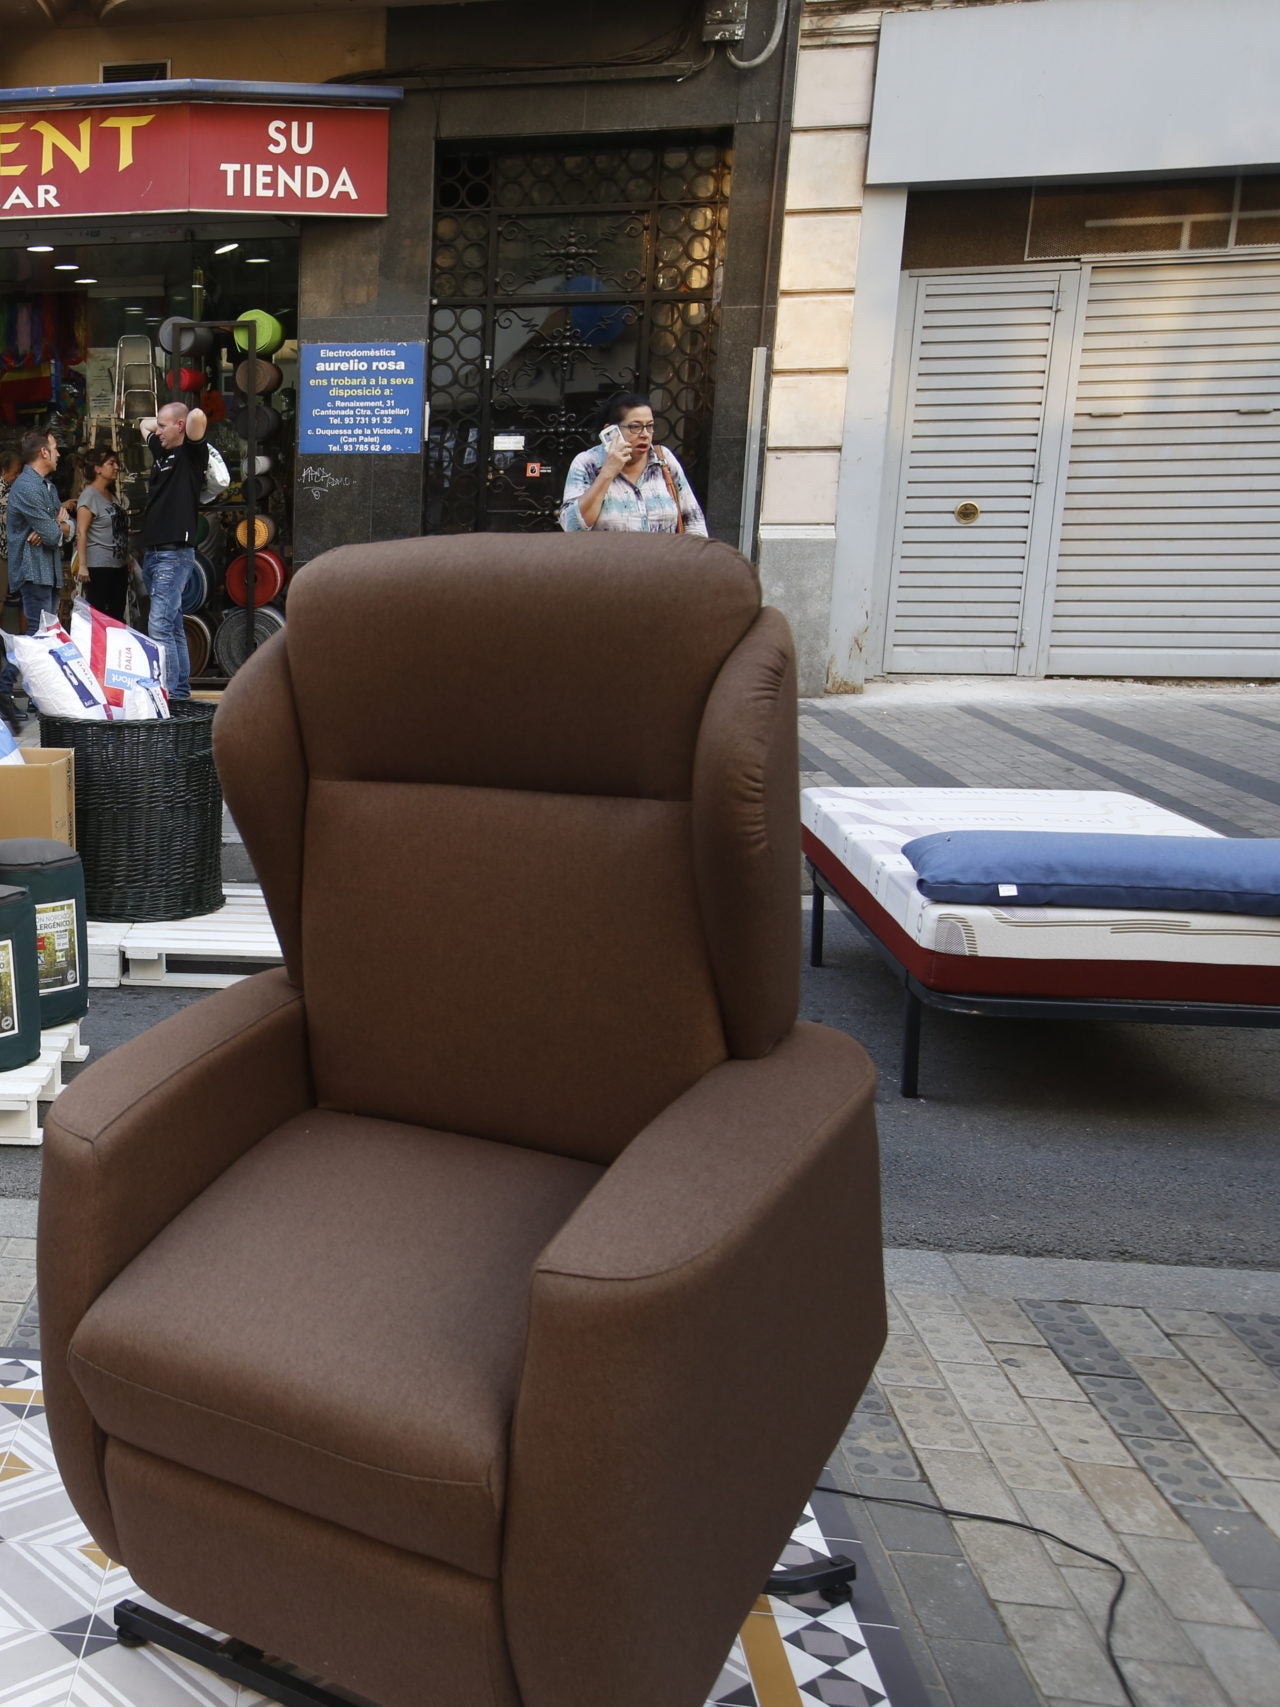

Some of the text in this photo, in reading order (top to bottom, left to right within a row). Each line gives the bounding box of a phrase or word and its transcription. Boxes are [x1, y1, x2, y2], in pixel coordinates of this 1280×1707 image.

[267, 120, 313, 154] SU
[220, 163, 358, 200] TIENDA
[316, 360, 405, 371] aurelio rosa
[379, 377, 387, 385] la
[329, 387, 381, 398] disposició
[312, 409, 354, 417] (Cantonada
[375, 408, 409, 416] Castellar)
[316, 428, 352, 436] Duquessa
[373, 427, 402, 435] Victoria,
[37, 920, 70, 930] LERGÉNICO
